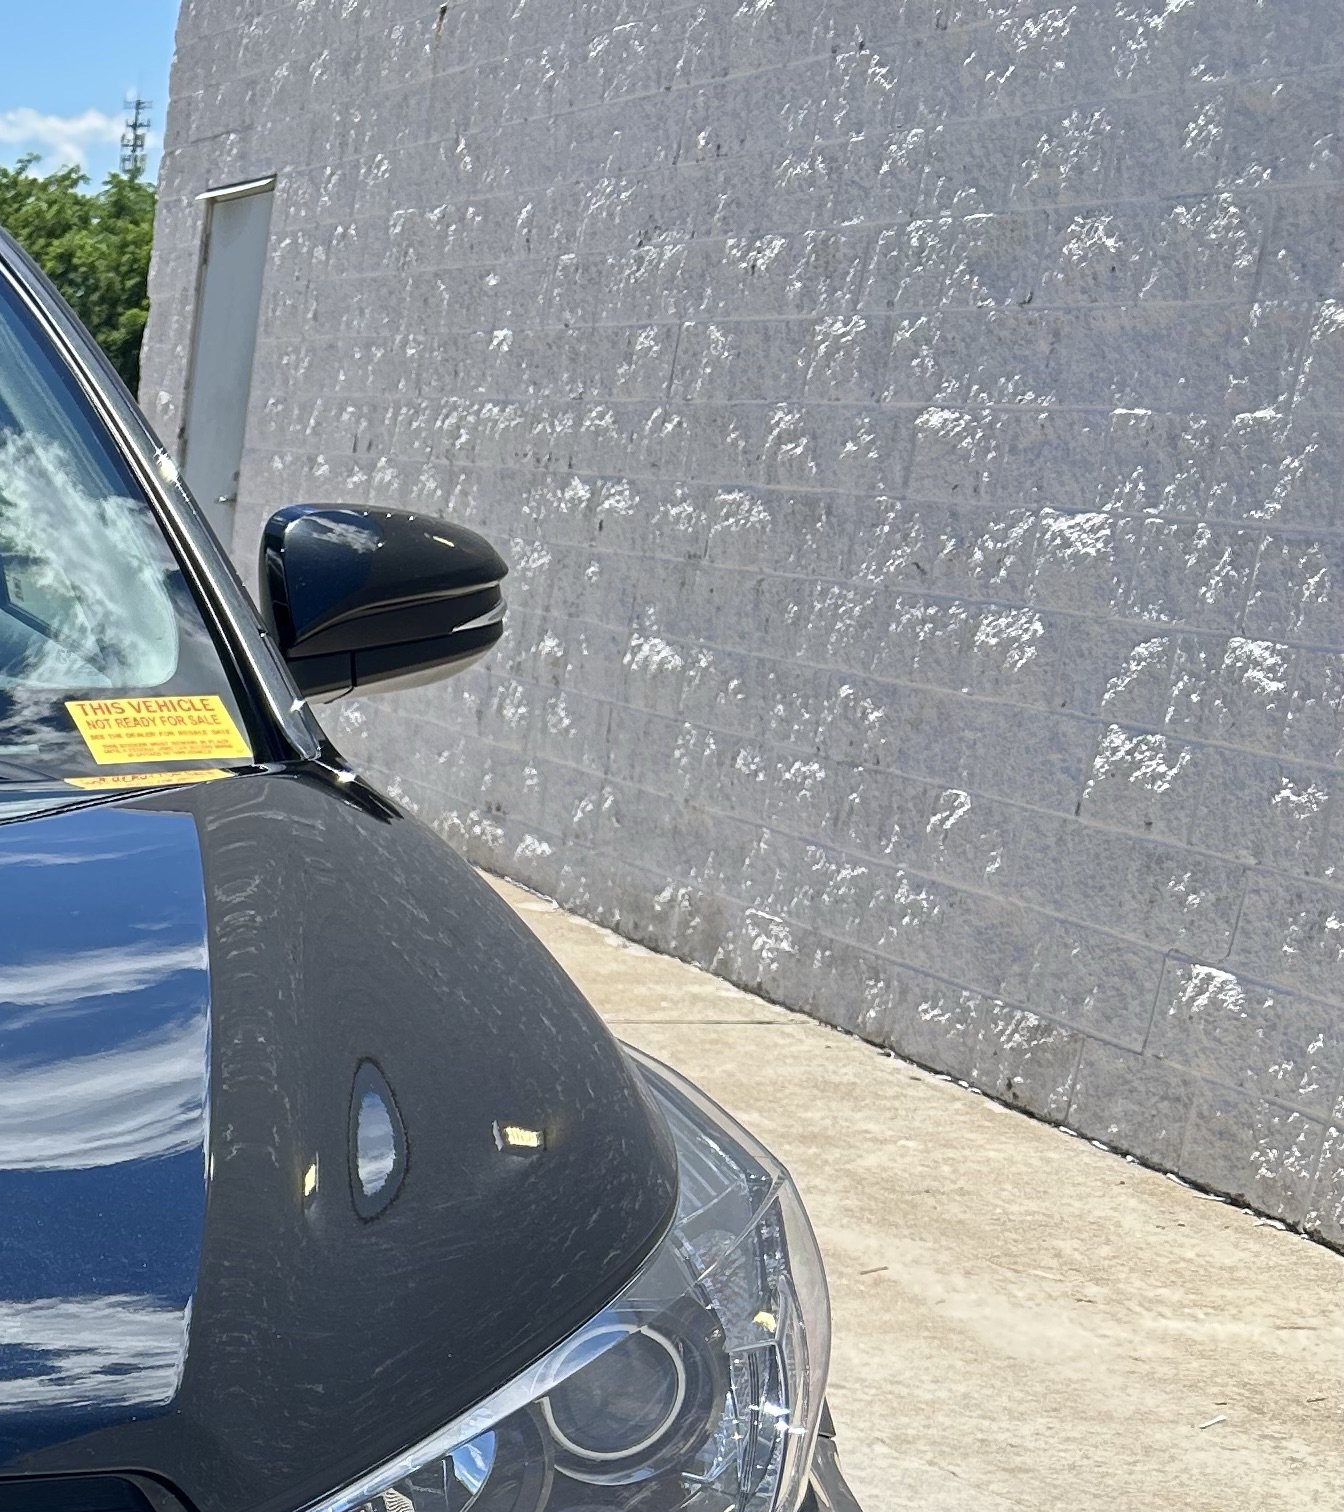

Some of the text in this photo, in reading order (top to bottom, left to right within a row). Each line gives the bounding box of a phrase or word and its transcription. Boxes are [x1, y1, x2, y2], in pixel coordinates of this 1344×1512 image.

[76, 699, 215, 717] THIS VEHICLE
[86, 714, 222, 731] NOT READY FOR SALE
